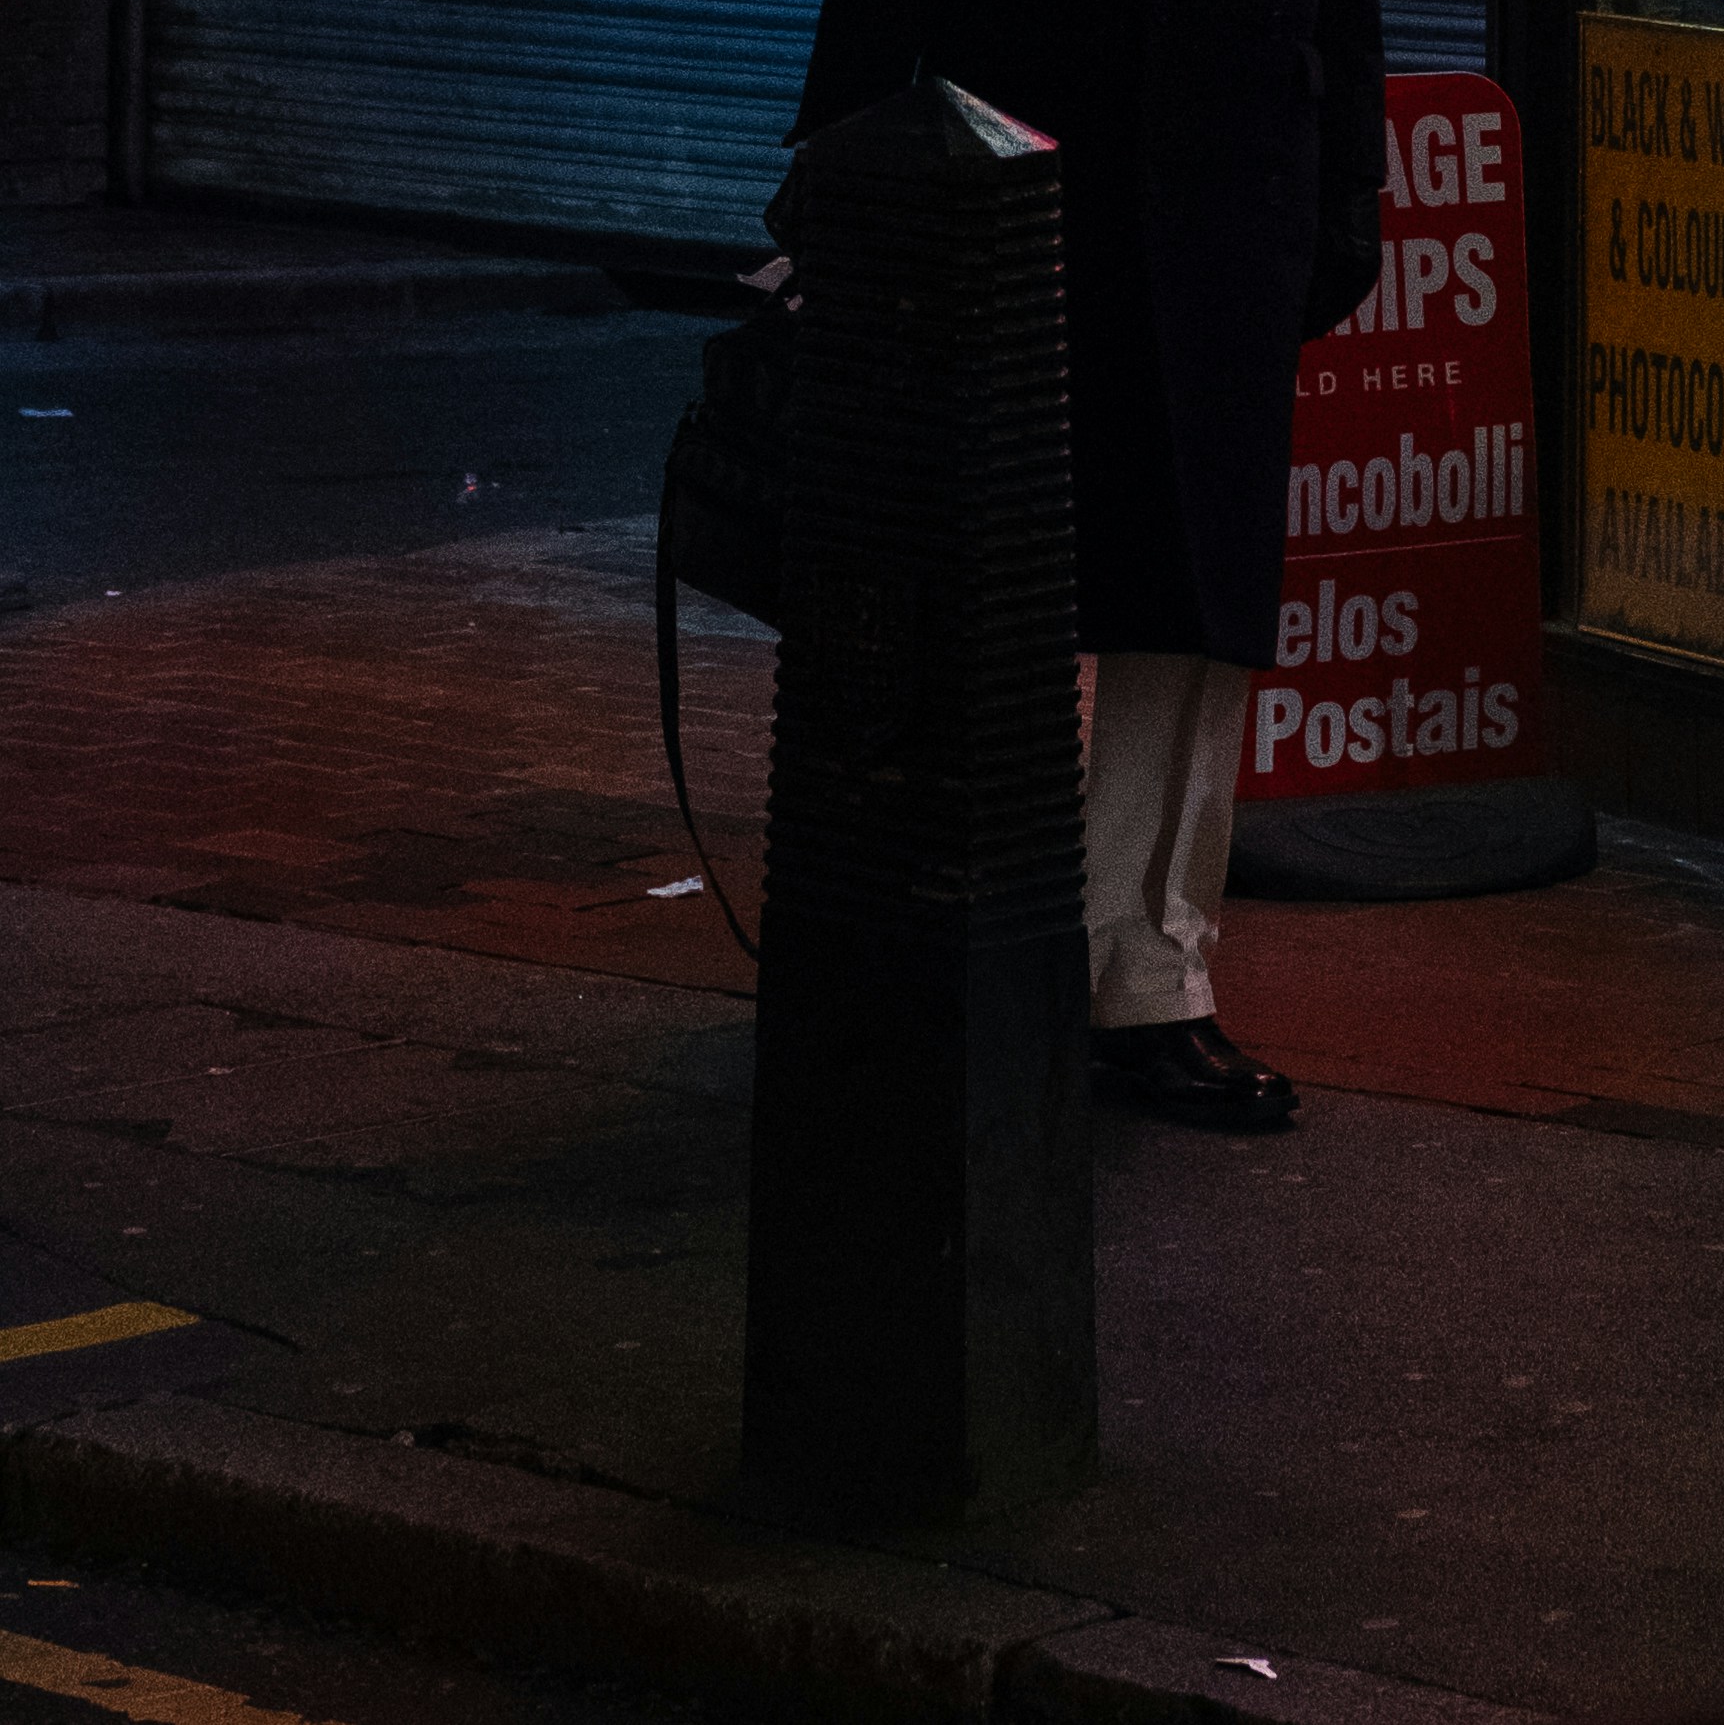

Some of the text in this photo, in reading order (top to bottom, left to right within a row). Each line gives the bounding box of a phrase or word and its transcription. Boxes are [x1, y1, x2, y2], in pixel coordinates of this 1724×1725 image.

[1589, 64, 1671, 159] BLACK
[1680, 76, 1696, 163] &
[1336, 231, 1498, 339] MPS
[1609, 199, 1627, 283] &
[1362, 360, 1464, 393] HERE
[1285, 421, 1526, 540] ncobolli
[1275, 579, 1422, 670] elos
[1254, 666, 1521, 775] Postais
